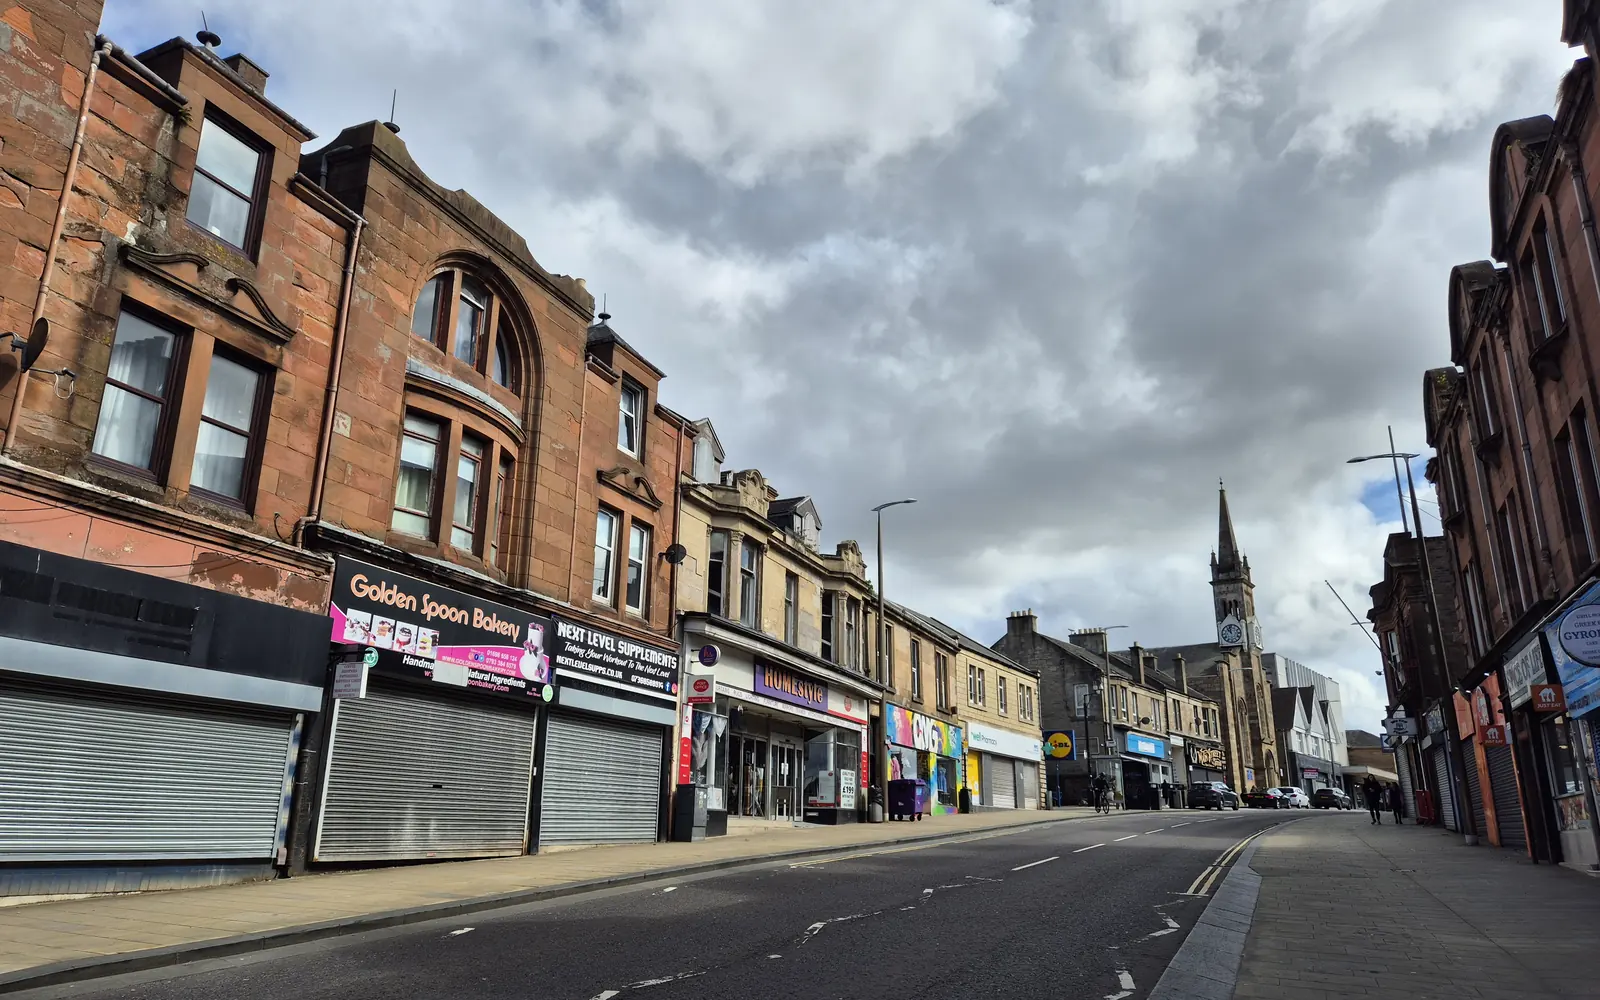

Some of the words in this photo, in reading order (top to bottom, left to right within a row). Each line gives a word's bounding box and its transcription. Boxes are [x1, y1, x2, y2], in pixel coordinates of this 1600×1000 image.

[350, 573, 417, 612] Golden
[420, 593, 469, 625] Spoon
[472, 607, 520, 643] Bakery
[557, 621, 586, 643] NEXT
[587, 630, 616, 653] LEVEL
[617, 640, 677, 670] SUPPLEMENTS
[564, 641, 585, 658] Taking
[584, 648, 604, 661] Your
[602, 652, 628, 666] Workout
[627, 658, 635, 669] To
[635, 661, 645, 672] The
[643, 664, 657, 675] Next
[656, 667, 671, 678] Level
[402, 654, 435, 670] Handma
[490, 673, 526, 688] Ingredients
[467, 679, 510, 692] oonbakery.com
[556, 655, 623, 679] NEXTLEVELSUPPS.CO.UK
[764, 664, 823, 705] HOMEstyle
